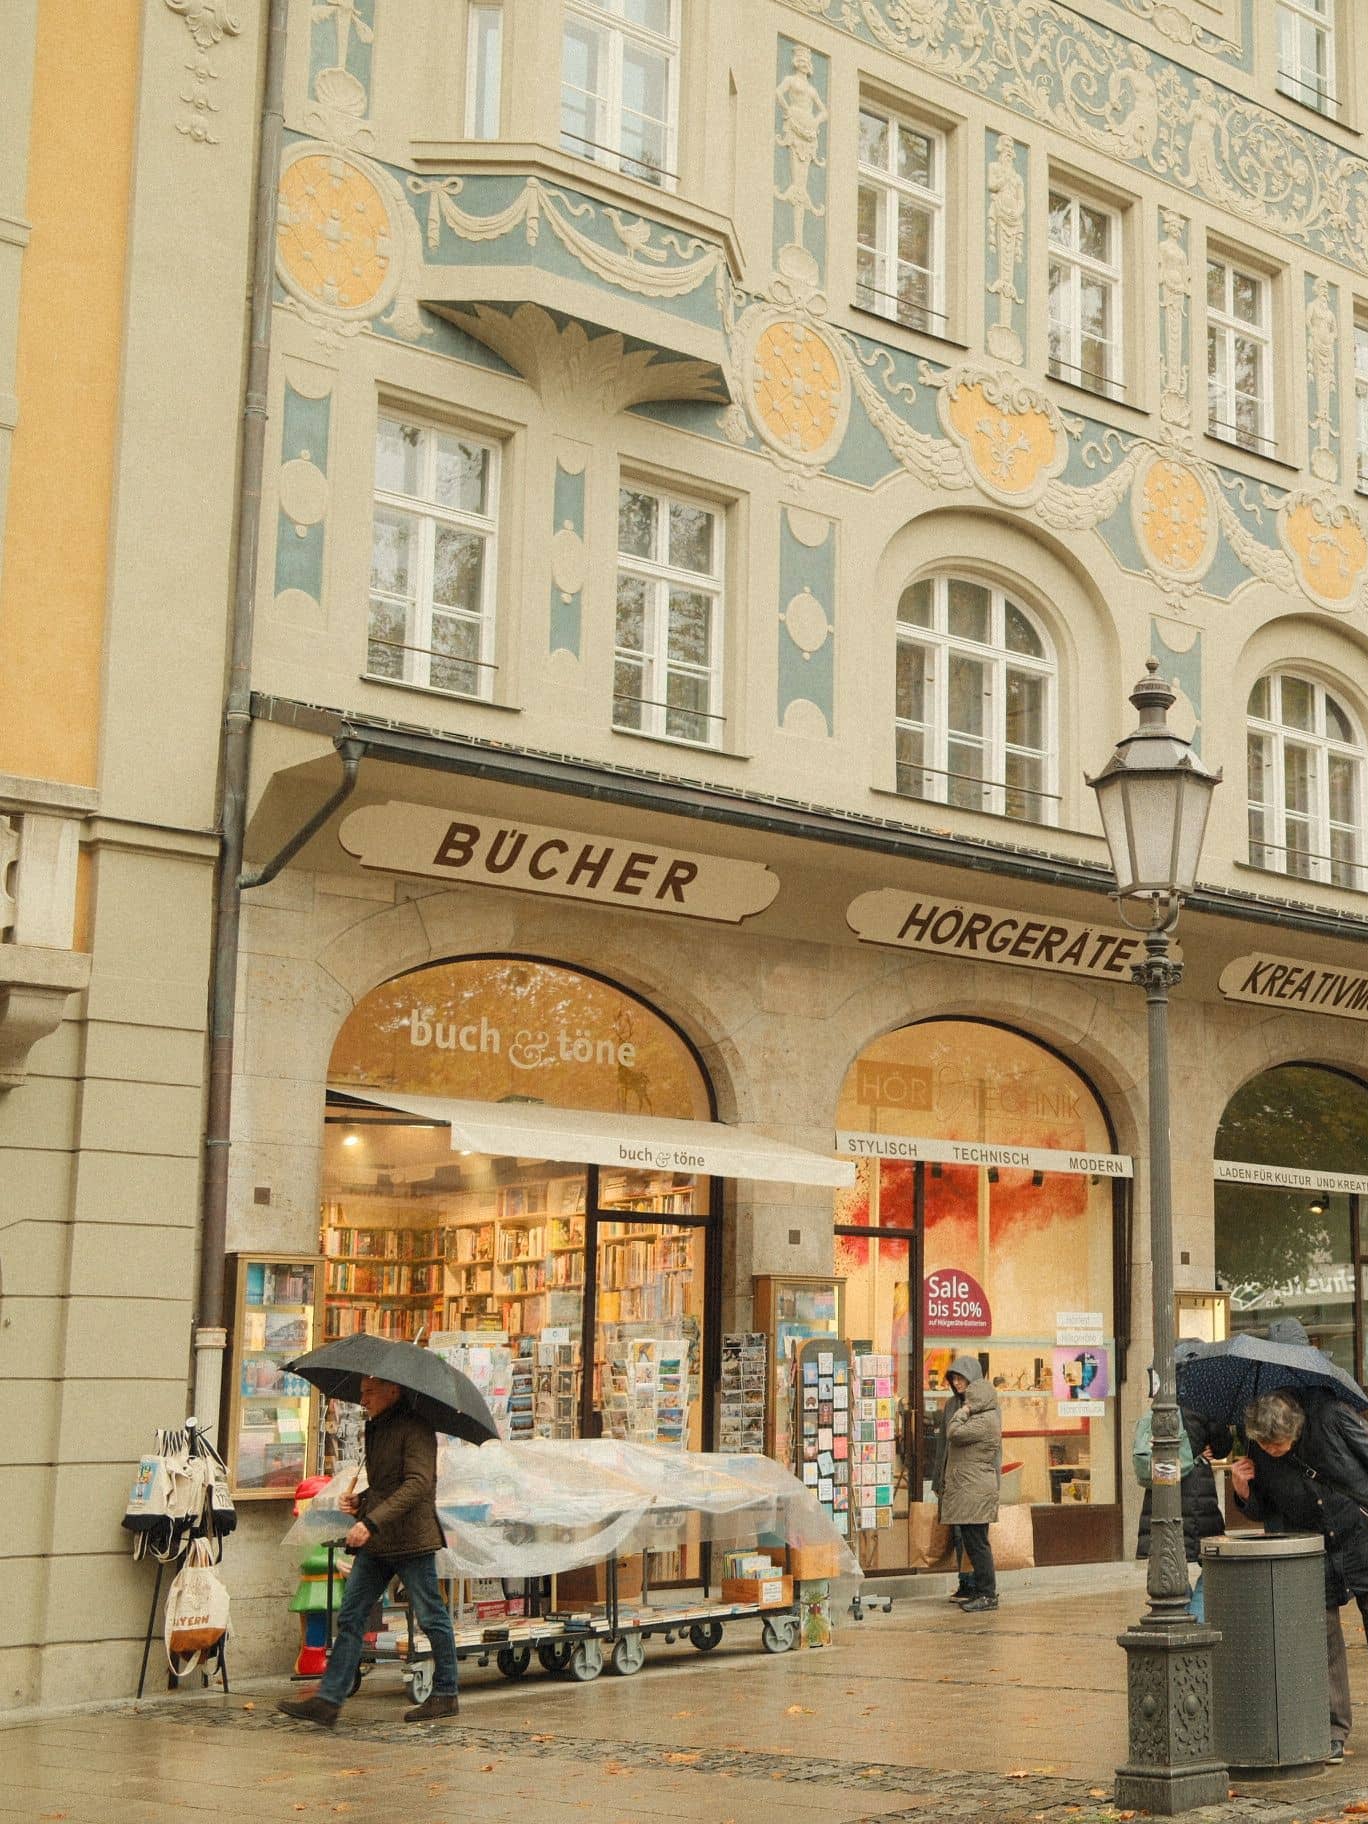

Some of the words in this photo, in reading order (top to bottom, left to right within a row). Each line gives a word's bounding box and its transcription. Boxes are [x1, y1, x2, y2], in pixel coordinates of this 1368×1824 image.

[432, 821, 699, 903] BÜCHER
[897, 903, 1140, 973] HÖRGERÄTE
[410, 1008, 500, 1053] buch
[508, 1030, 549, 1070] &
[558, 1029, 636, 1068] töne
[863, 1071, 927, 1104] HÖR
[619, 1144, 652, 1161] buch
[655, 1152, 671, 1167] &
[673, 1151, 705, 1166] töne
[849, 1139, 917, 1156] STYLISCH
[953, 1146, 1029, 1165] TECHNISCH
[1069, 1157, 1124, 1173] MODERN
[1219, 1167, 1252, 1179] LADEN
[1254, 1168, 1273, 1182] FÜR
[1275, 1172, 1311, 1186] KULTUR
[1317, 1177, 1336, 1188] UND
[928, 1275, 969, 1298] Sale
[928, 1300, 949, 1316] bis
[952, 1301, 982, 1317] 50%
